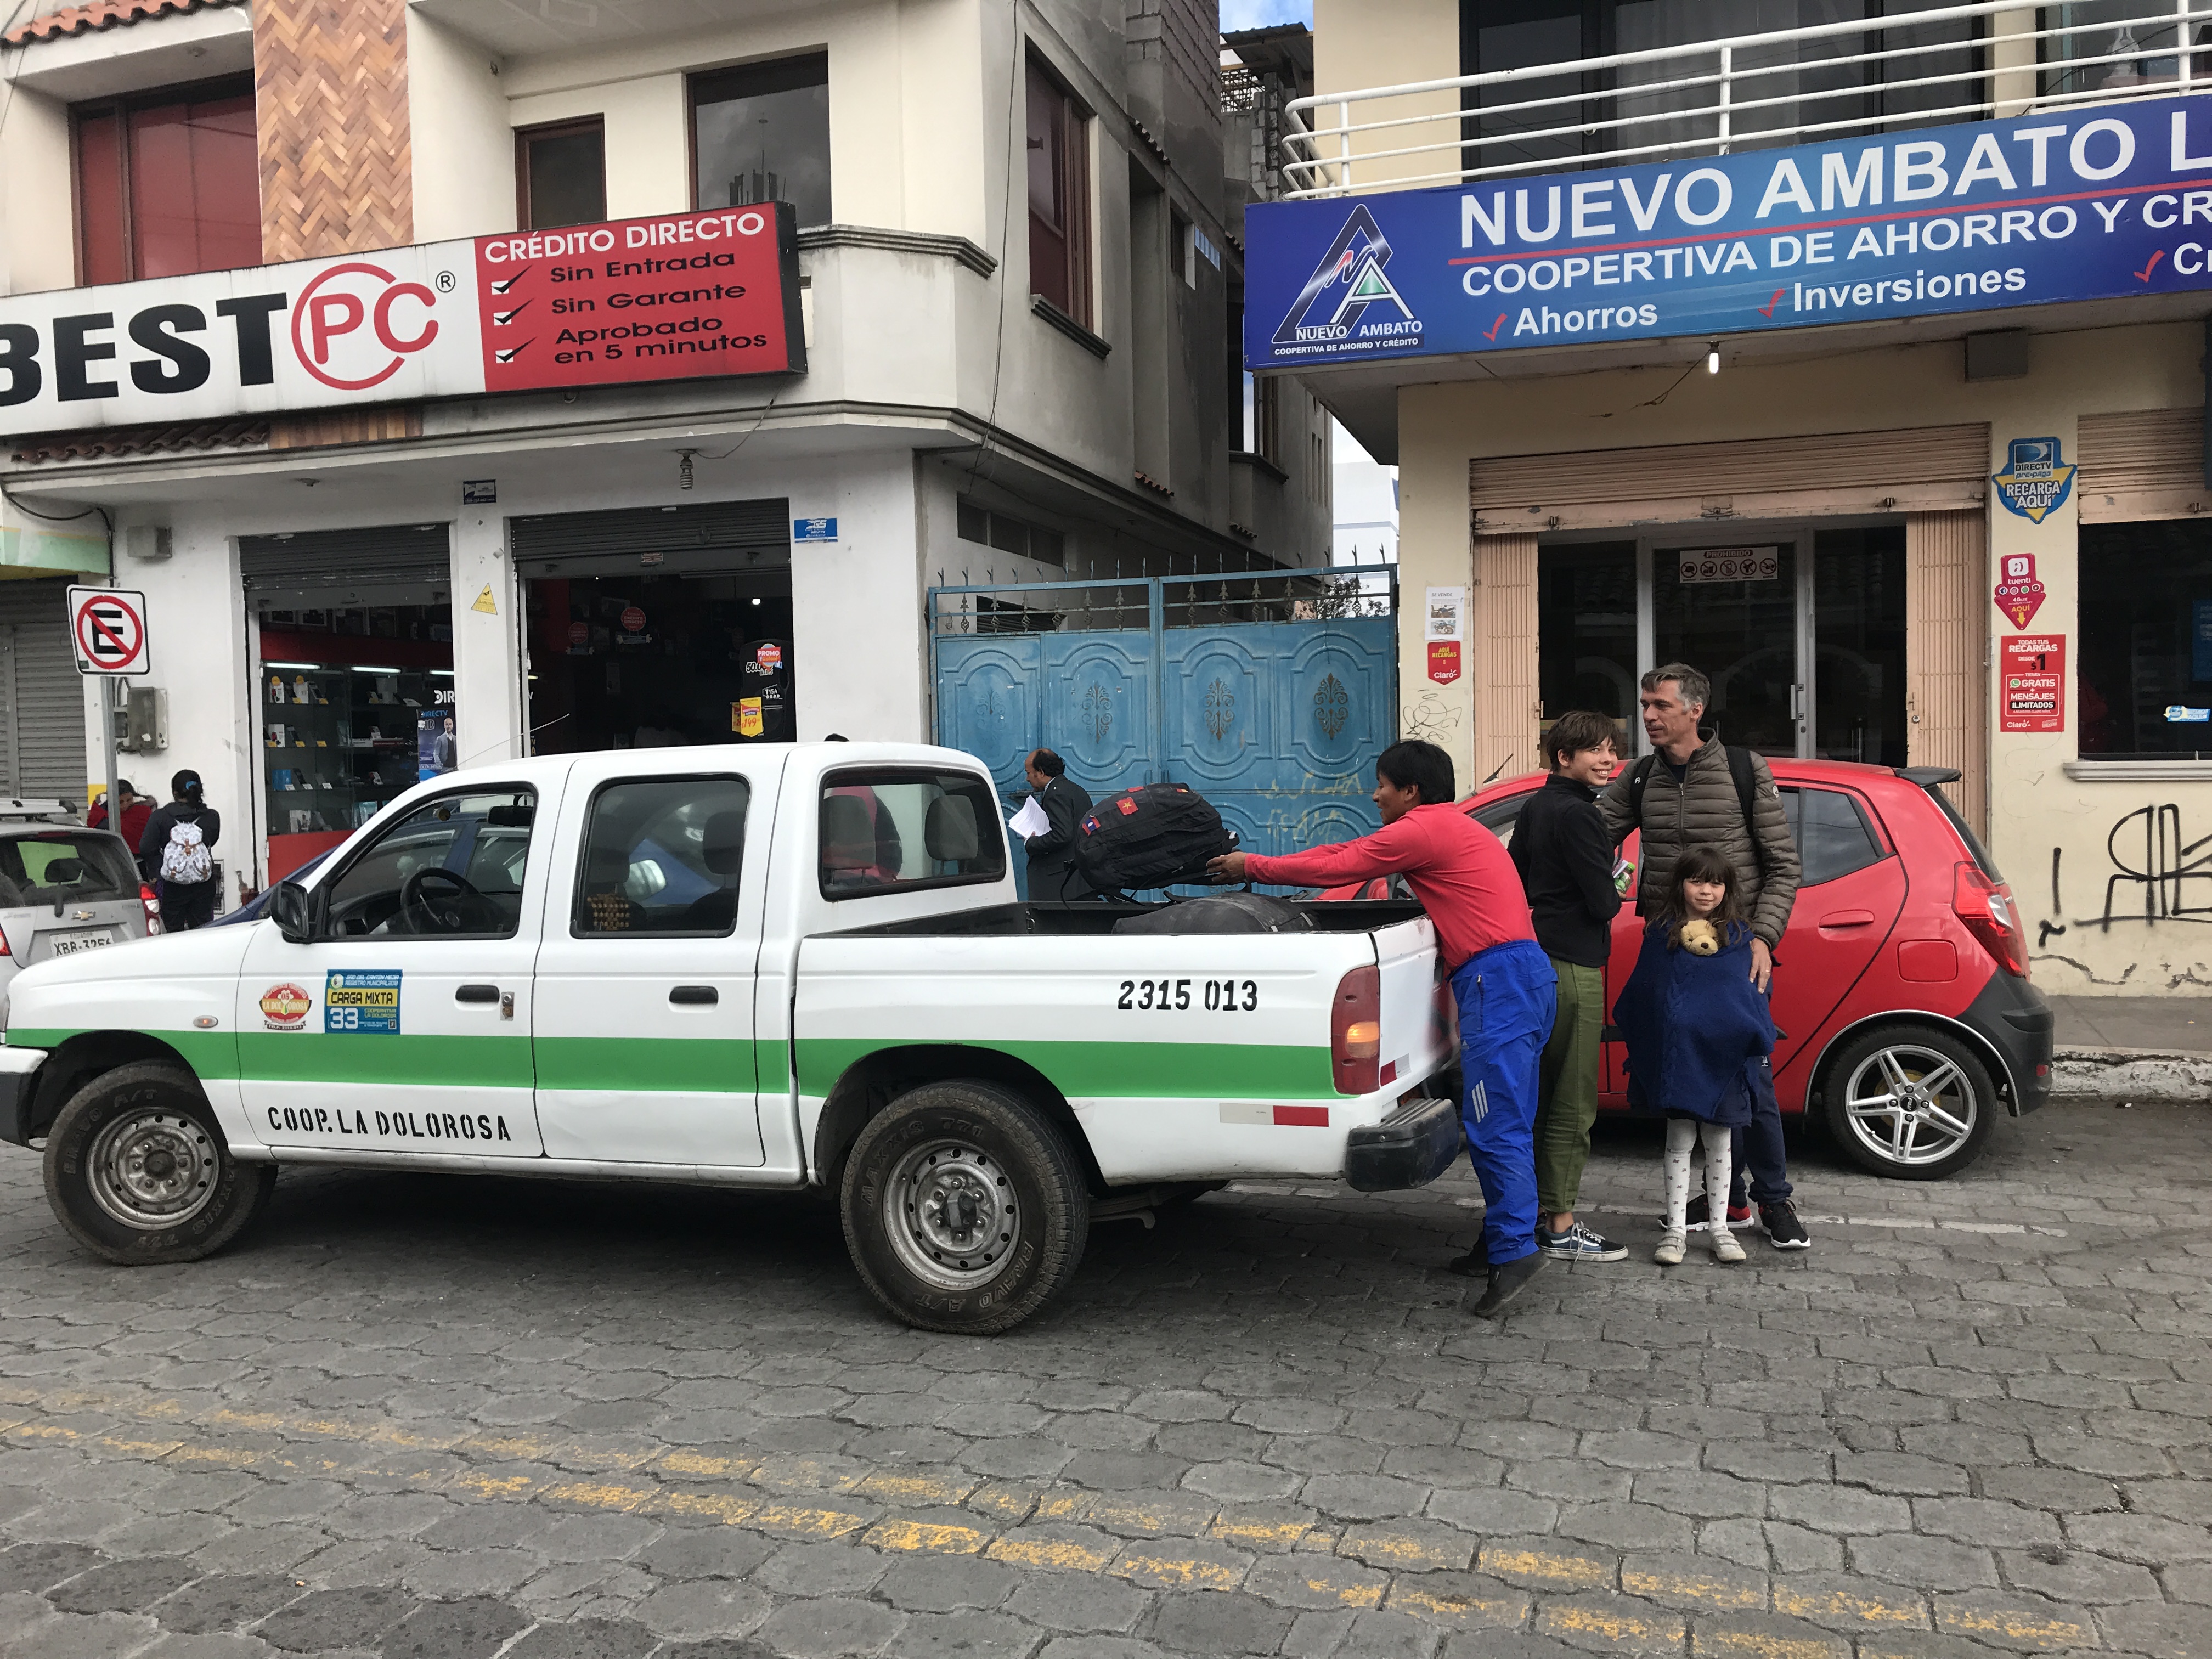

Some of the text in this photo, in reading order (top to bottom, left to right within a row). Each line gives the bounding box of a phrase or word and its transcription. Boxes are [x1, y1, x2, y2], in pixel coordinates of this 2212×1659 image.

[1461, 167, 1733, 249] NUEVO
[1755, 119, 2136, 218] AMBATO
[484, 212, 765, 263] CRÉDITO DIRECTO
[1462, 240, 1757, 296] COOPERTIVA
[1770, 230, 1835, 268] DE
[1847, 205, 2077, 260] AHORRO
[2091, 199, 2128, 233] Y
[550, 251, 735, 283] Sin Entrada
[551, 283, 746, 314] Sin Garante
[1794, 267, 2027, 312] Inversiones
[555, 316, 723, 345] Aprobado
[1296, 321, 1423, 341] NUEVO AMBATO
[1513, 303, 1658, 336] Ahorros
[0, 292, 288, 407] BEST
[554, 331, 768, 364] en 5 minutos
[1274, 345, 1325, 356] COOPERTIVA
[1339, 342, 1373, 350] AHORRO
[1383, 338, 1419, 347] CRÉDITO
[2016, 462, 2052, 471] DIRECTV
[2006, 482, 2061, 496] RECARGA
[2008, 644, 2058, 653] RECARGAS
[1434, 670, 1455, 679] Claro
[2021, 679, 2056, 687] GRATIS
[263, 1001, 270, 1010] LA
[331, 992, 393, 1005] CARGA MIXTA
[1118, 979, 1259, 1011] 2315 013
[330, 1007, 359, 1029] 33
[267, 1106, 511, 1142] COOP. LA DOLOROSA
[860, 1120, 924, 1207] MAXXIS
